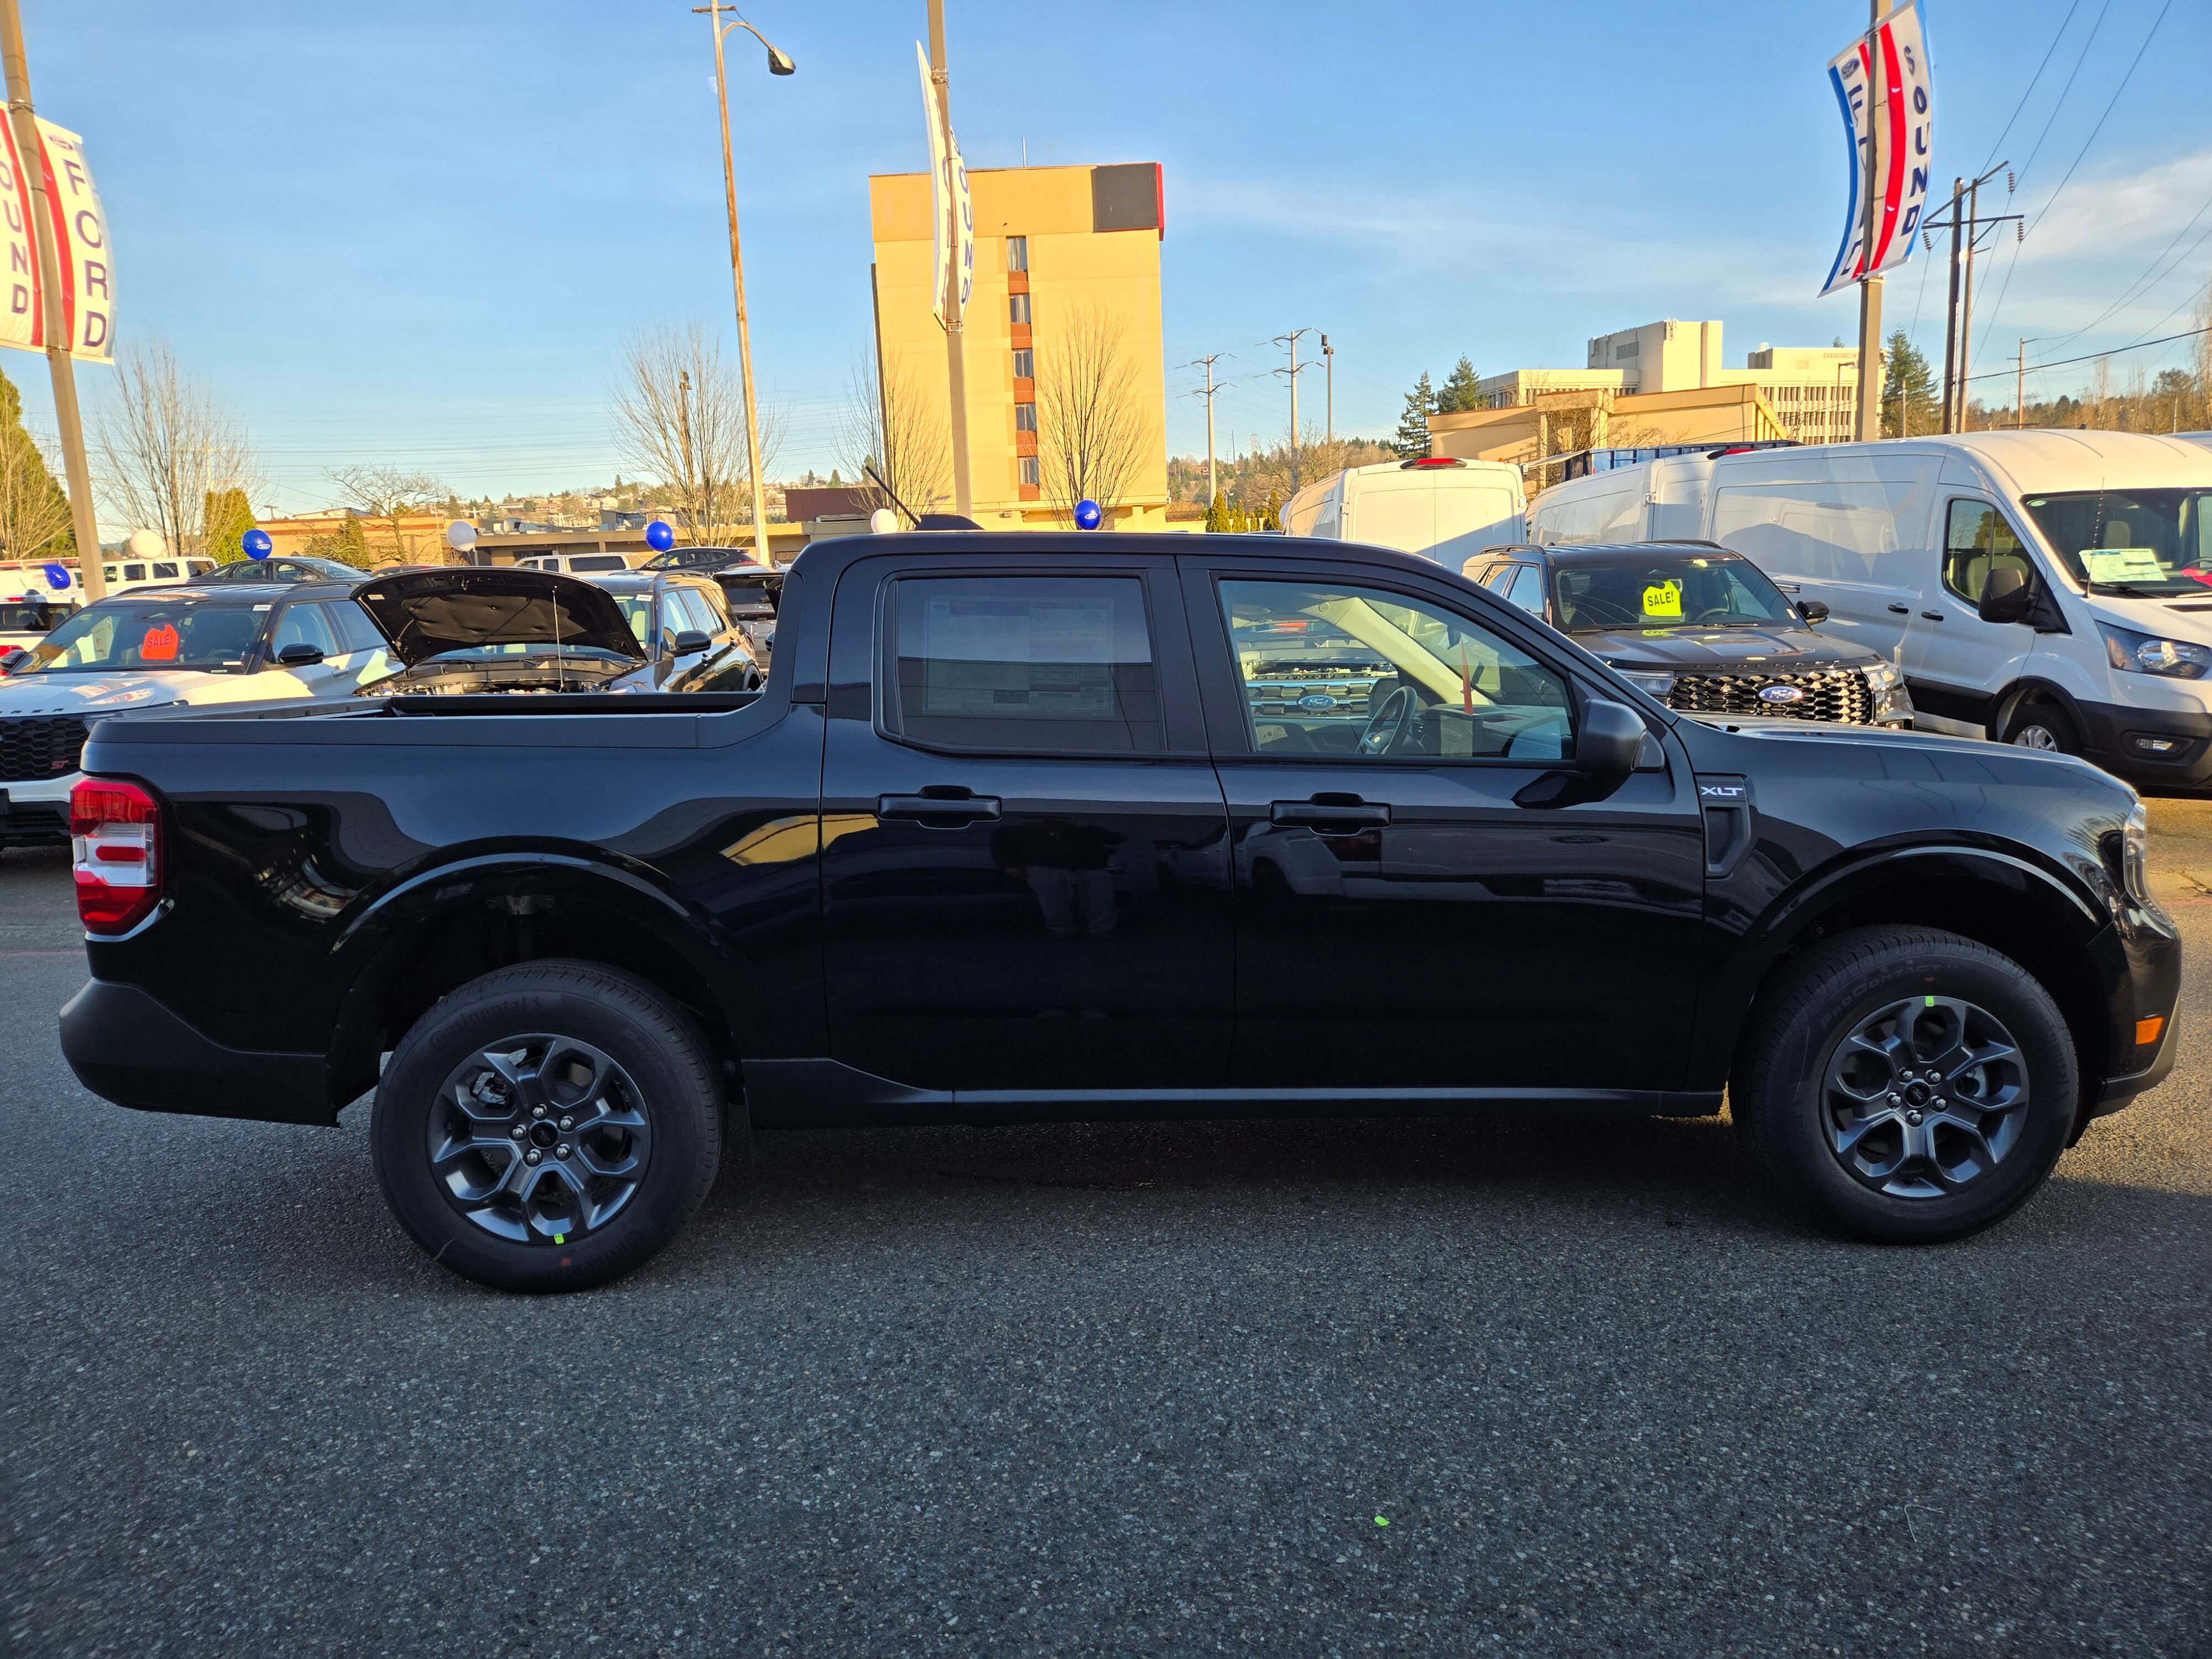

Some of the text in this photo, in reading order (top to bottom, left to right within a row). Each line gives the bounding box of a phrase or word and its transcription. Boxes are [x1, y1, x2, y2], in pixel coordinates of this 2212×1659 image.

[1904, 44, 1932, 237] SOUND
[0, 159, 28, 315] OUND
[61, 158, 108, 347] FORD
[1647, 591, 1674, 607] SALE!
[148, 633, 172, 648] SALE!
[50, 760, 70, 770] ST
[1700, 786, 1743, 796] XLT
